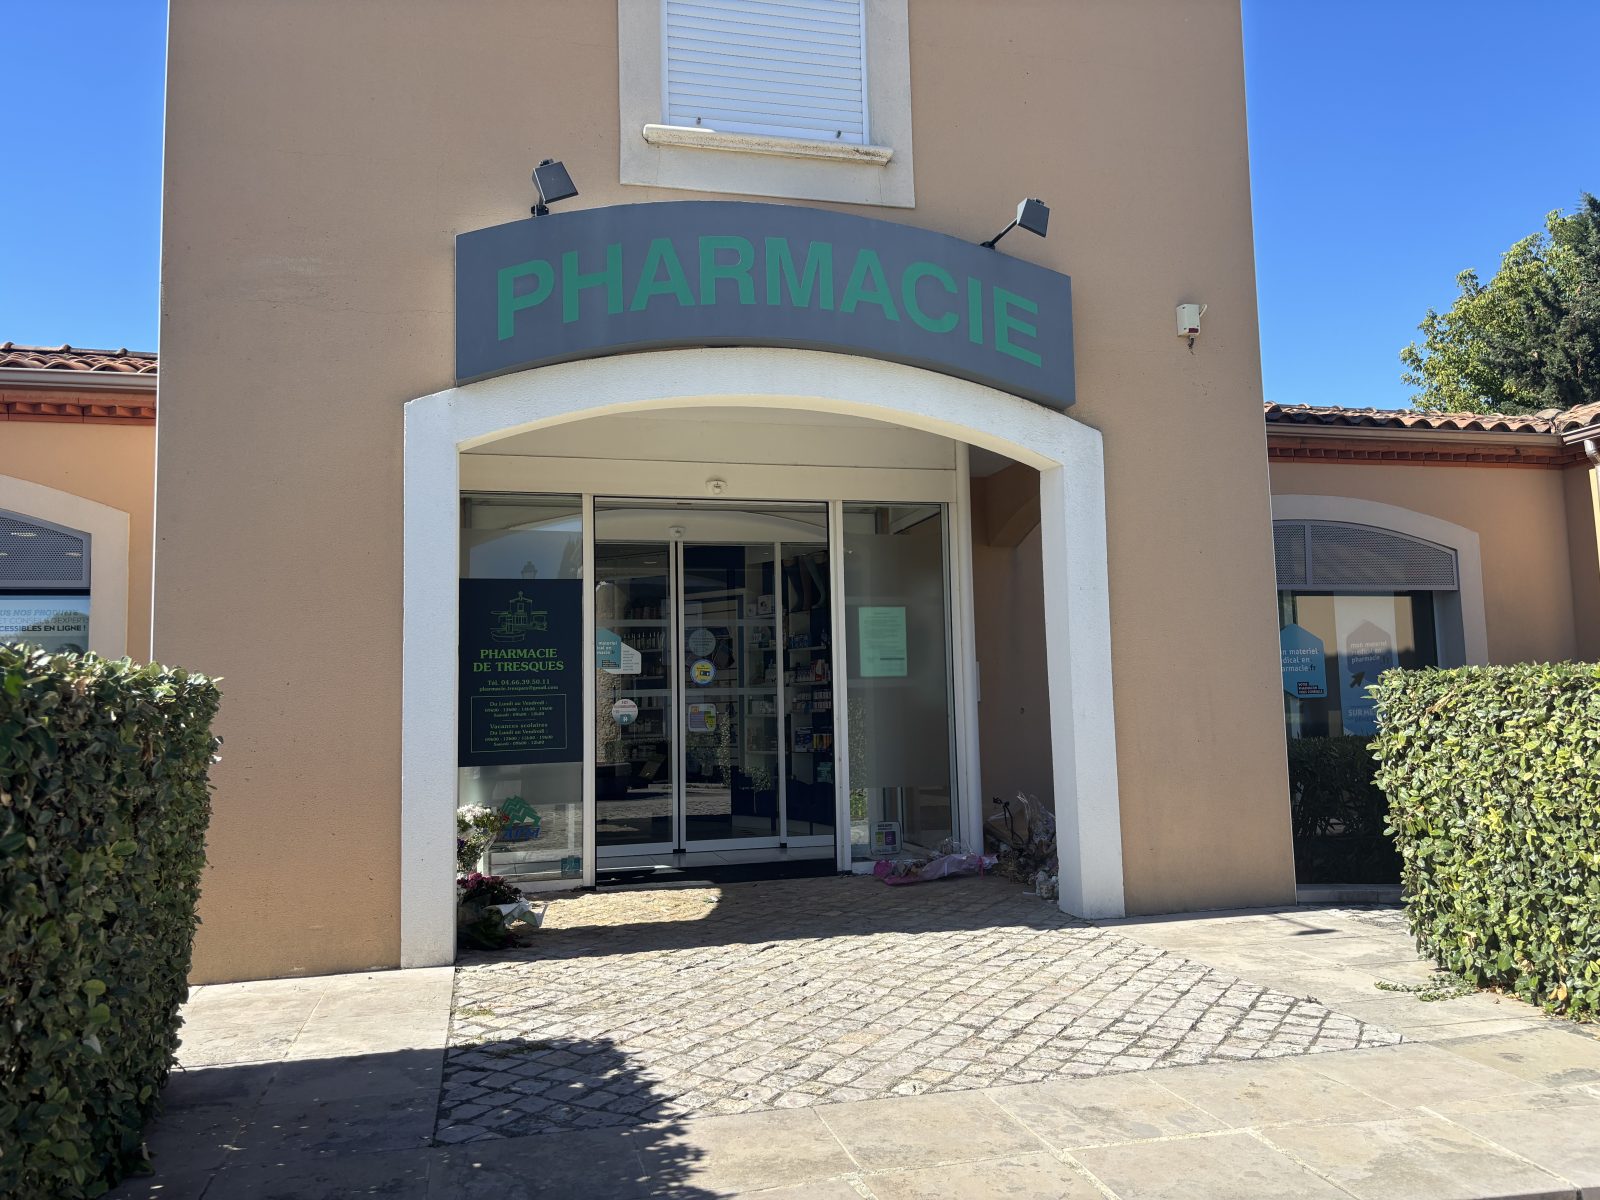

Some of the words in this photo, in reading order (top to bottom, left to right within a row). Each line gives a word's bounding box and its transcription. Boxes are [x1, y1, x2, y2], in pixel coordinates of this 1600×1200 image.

[497, 235, 1042, 368] PHARMACIE
[480, 648, 558, 659] PHARMACIE
[1289, 647, 1319, 656] materiel
[1282, 656, 1299, 664] dical
[473, 662, 492, 672] DE
[495, 661, 564, 672] TRESQUES
[1281, 664, 1316, 672] armacie.fr
